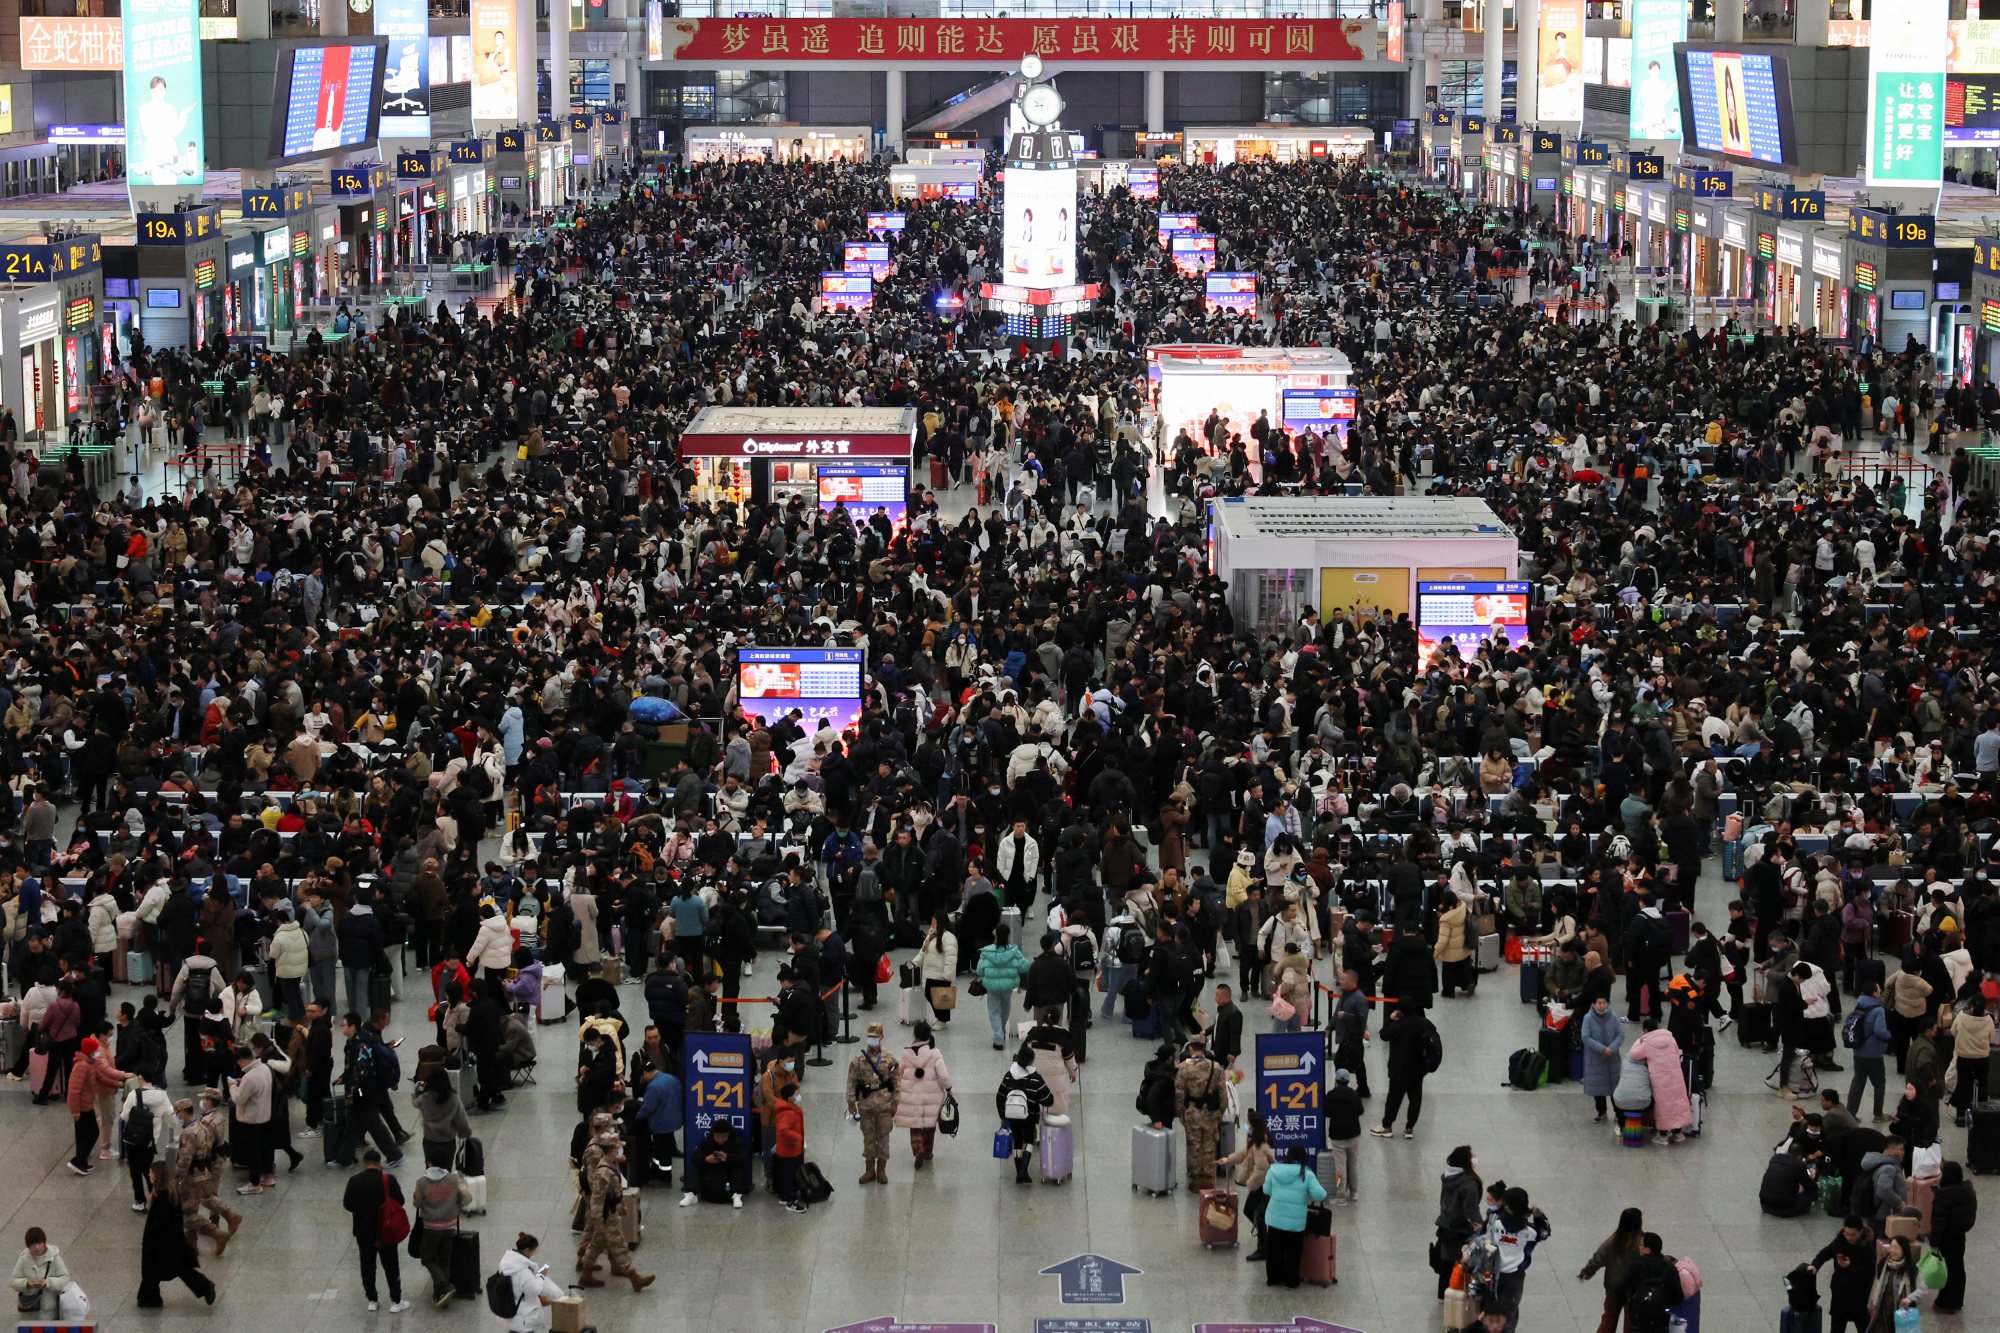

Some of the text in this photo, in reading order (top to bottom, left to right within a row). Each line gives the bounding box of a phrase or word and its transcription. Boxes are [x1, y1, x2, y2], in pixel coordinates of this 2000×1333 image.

[721, 24, 1314, 54] 梦虽遥 追则能达 愿虽艰 持则可圆
[604, 110, 615, 122] 3A
[1438, 114, 1449, 123] 3B
[1896, 82, 1915, 161] 让家更好
[575, 119, 586, 129] 5A
[1468, 121, 1479, 131] 5B
[541, 128, 553, 138] 7A
[1502, 129, 1514, 139] 7B
[503, 137, 517, 148] 9A
[1540, 138, 1553, 149] 9B
[456, 147, 477, 158] 11A
[1582, 148, 1602, 161] 11B
[402, 160, 425, 173] 13A
[1636, 161, 1658, 174] 13B
[337, 175, 362, 189] 15A
[1702, 177, 1726, 191] 15B
[249, 197, 278, 212] 17A
[1790, 198, 1818, 214] 17B
[145, 221, 176, 238] 19A
[1896, 223, 1927, 241] 19B
[6, 253, 45, 274] 21A
[806, 440, 850, 454] 外交官
[691, 1080, 743, 1108] 1-21
[1264, 1081, 1318, 1110] 1-21
[1266, 1114, 1317, 1131] 检票口
[1275, 1132, 1308, 1140] Check-in
